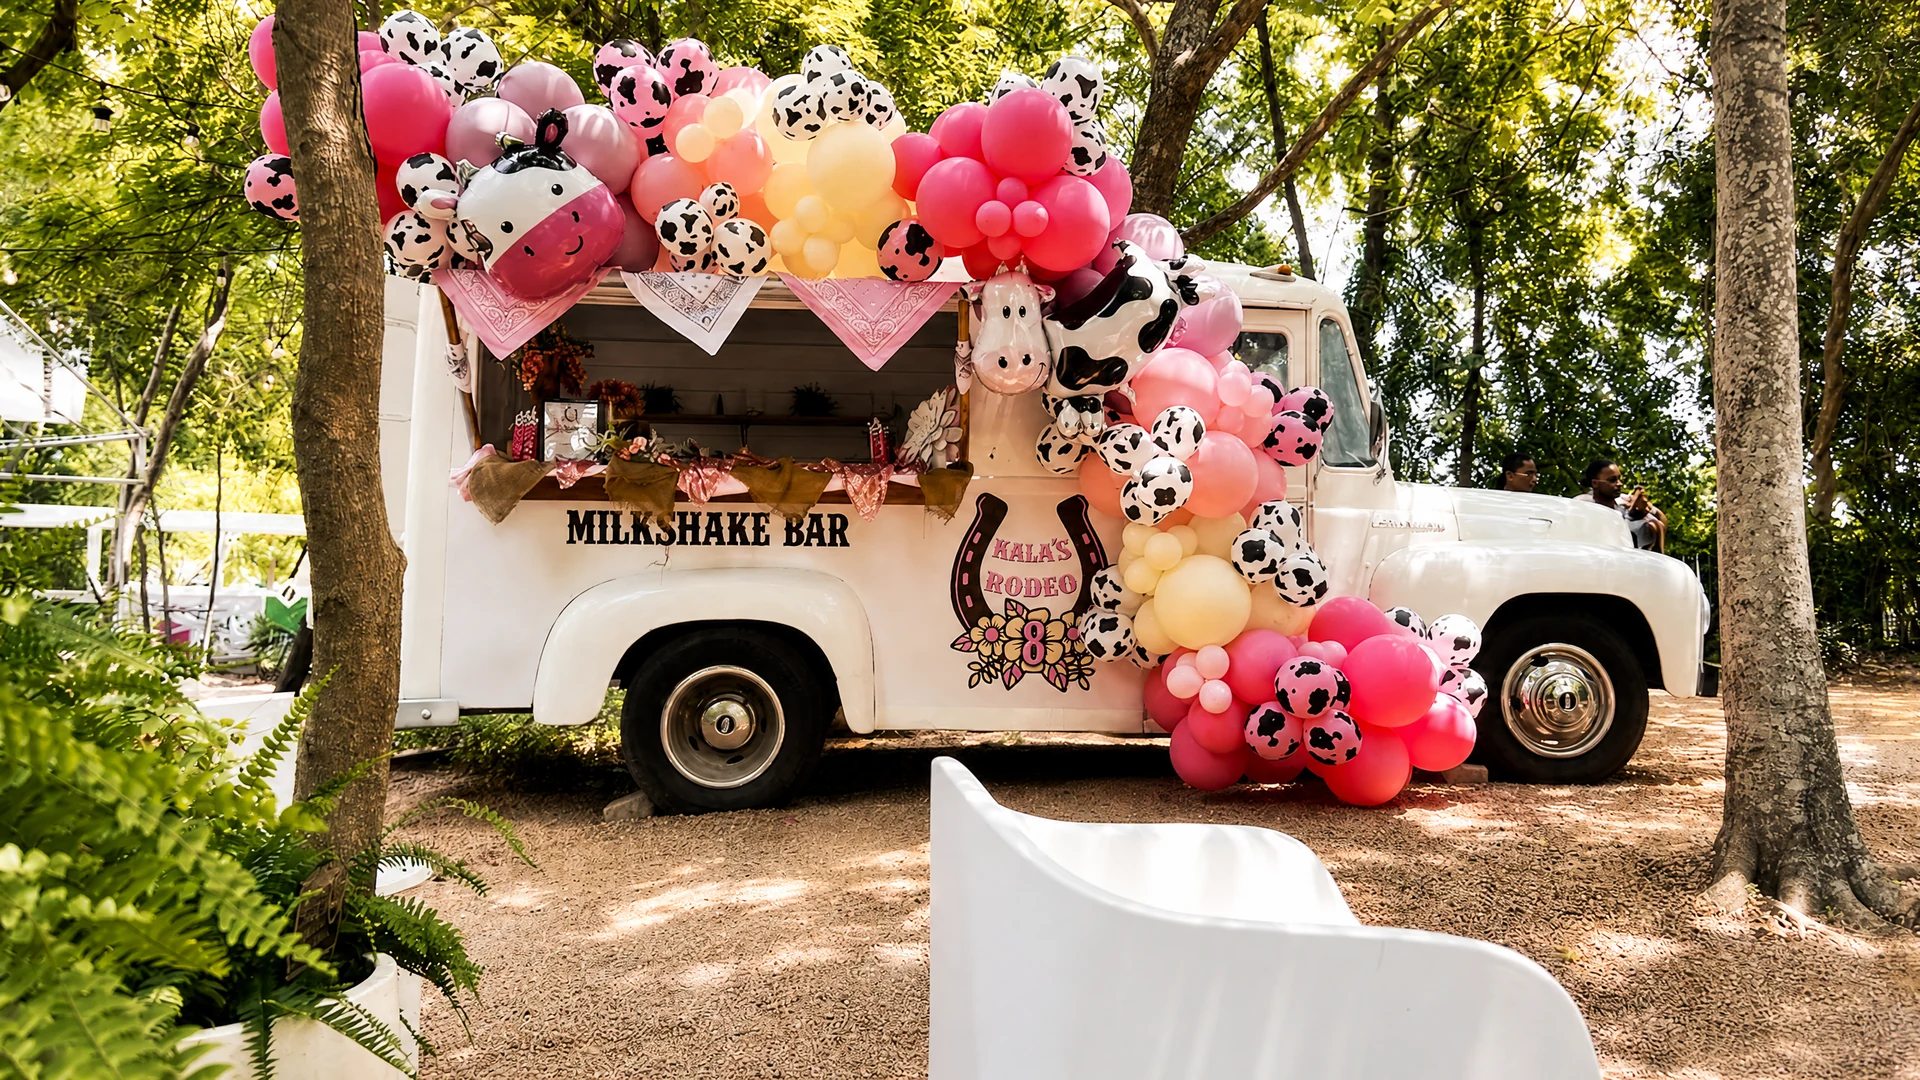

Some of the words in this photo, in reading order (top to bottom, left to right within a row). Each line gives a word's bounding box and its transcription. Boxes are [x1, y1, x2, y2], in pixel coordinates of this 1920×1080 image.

[566, 509, 770, 546] MILKSHAKE
[783, 512, 850, 547] BAR
[991, 538, 1072, 563] KALA'S
[984, 570, 1077, 598] RODEO
[1022, 620, 1045, 665] 8
